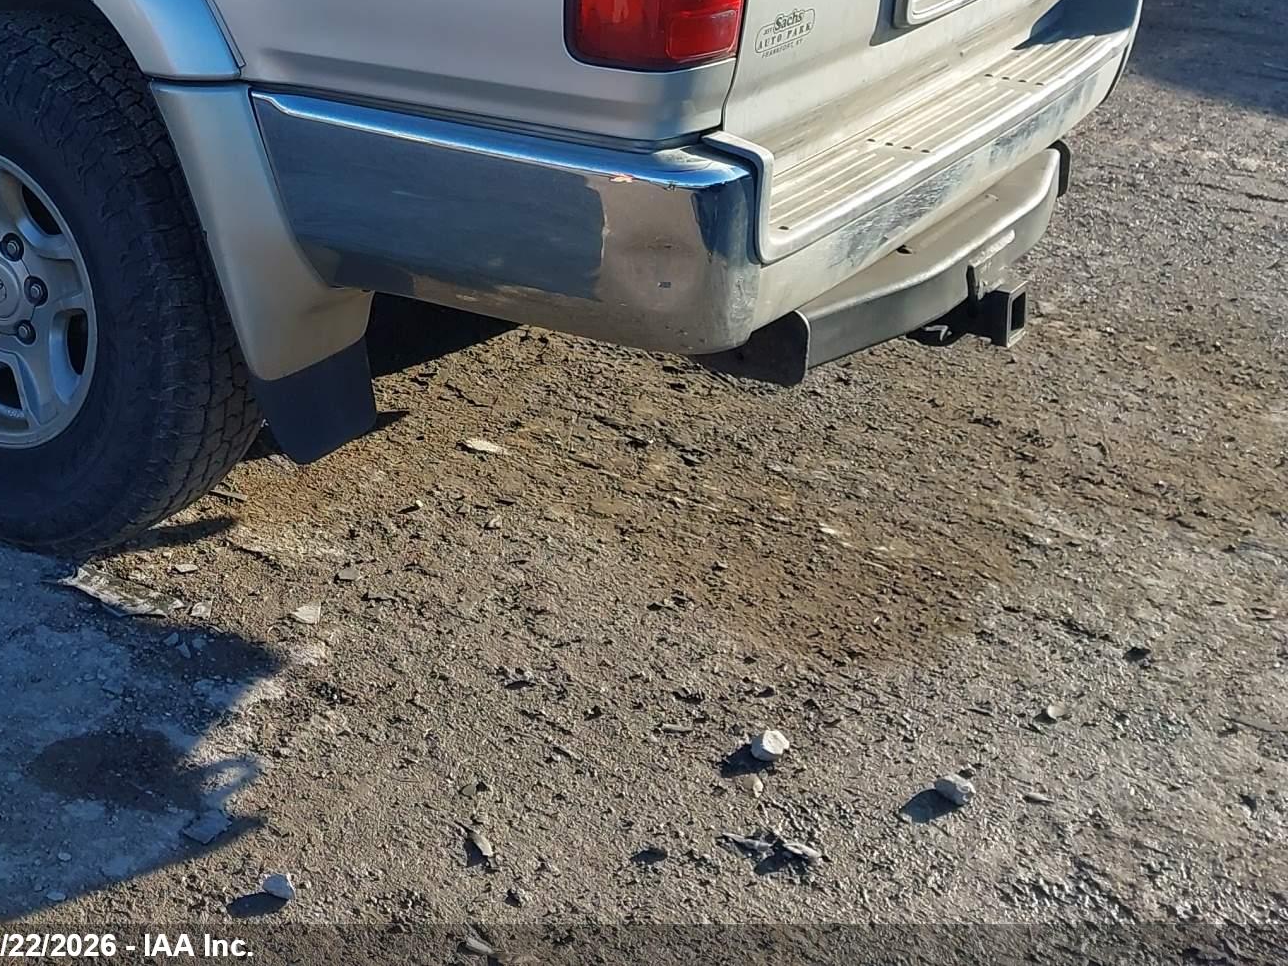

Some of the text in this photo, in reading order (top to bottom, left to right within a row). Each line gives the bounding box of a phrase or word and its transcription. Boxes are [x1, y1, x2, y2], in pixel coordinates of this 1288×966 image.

[775, 11, 804, 31] Sachs
[757, 21, 812, 51] AUTO PARK
